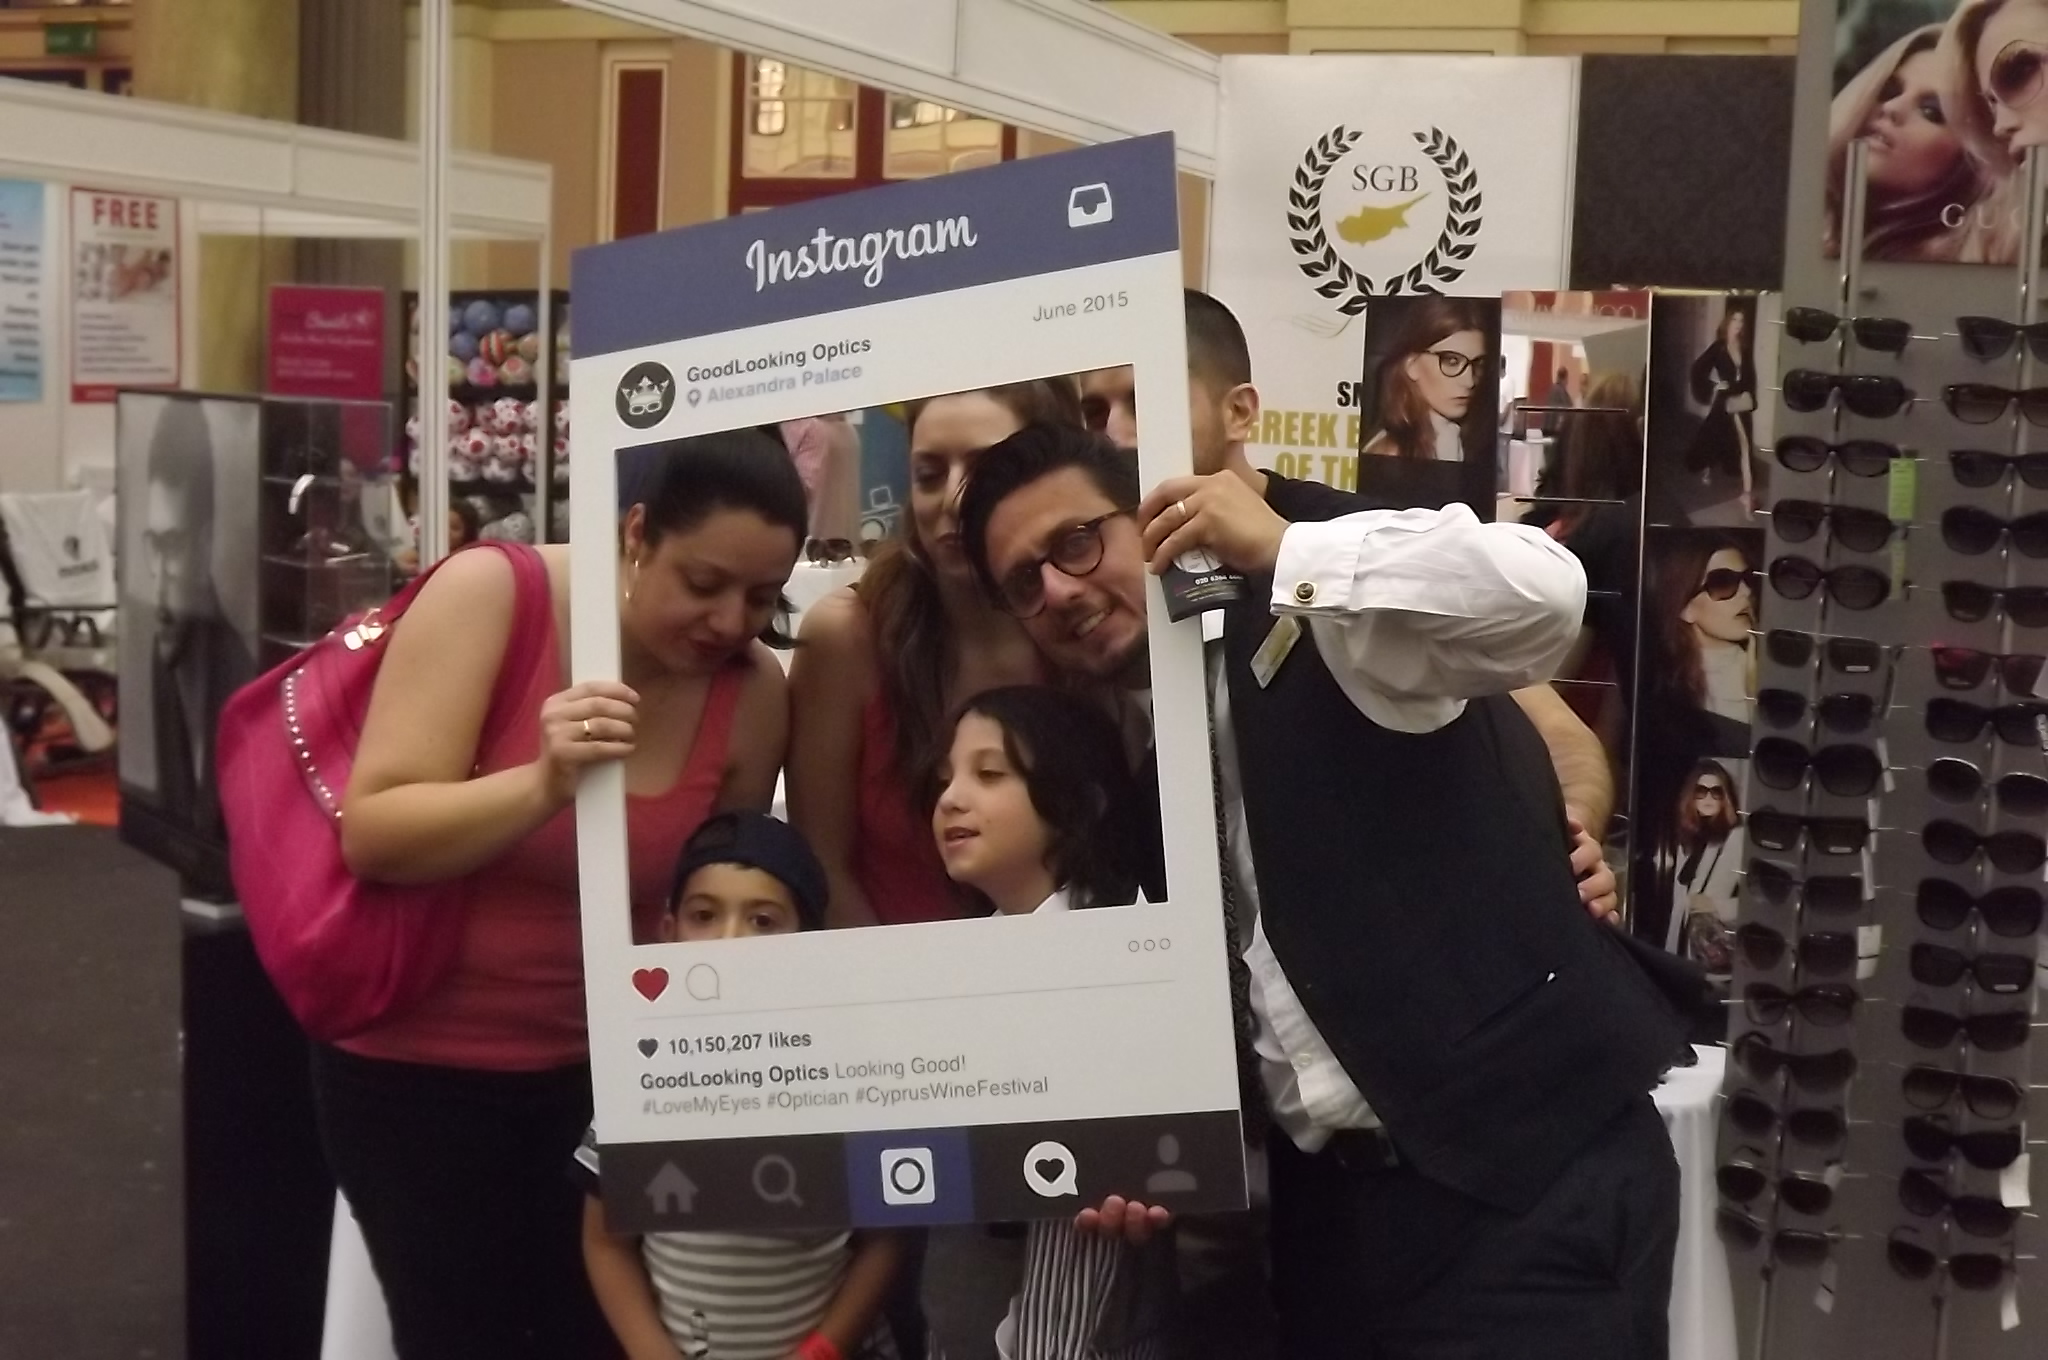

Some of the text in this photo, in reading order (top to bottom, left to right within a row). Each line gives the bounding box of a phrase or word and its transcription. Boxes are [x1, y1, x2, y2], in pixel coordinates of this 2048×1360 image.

[1351, 164, 1419, 192] SGB
[92, 197, 159, 229] FREE
[745, 214, 978, 292] Instagram
[1033, 291, 1129, 322] June 2015
[687, 338, 872, 383] GoodLooking Optics
[707, 364, 863, 403] Alexandra Palace
[669, 1031, 812, 1056] 10,150,207 likes
[640, 1054, 966, 1090] GoodLooking Optics Looking Good!
[643, 1076, 1049, 1116] #LoveMyEyes #Optician #CyprusWineFestival
